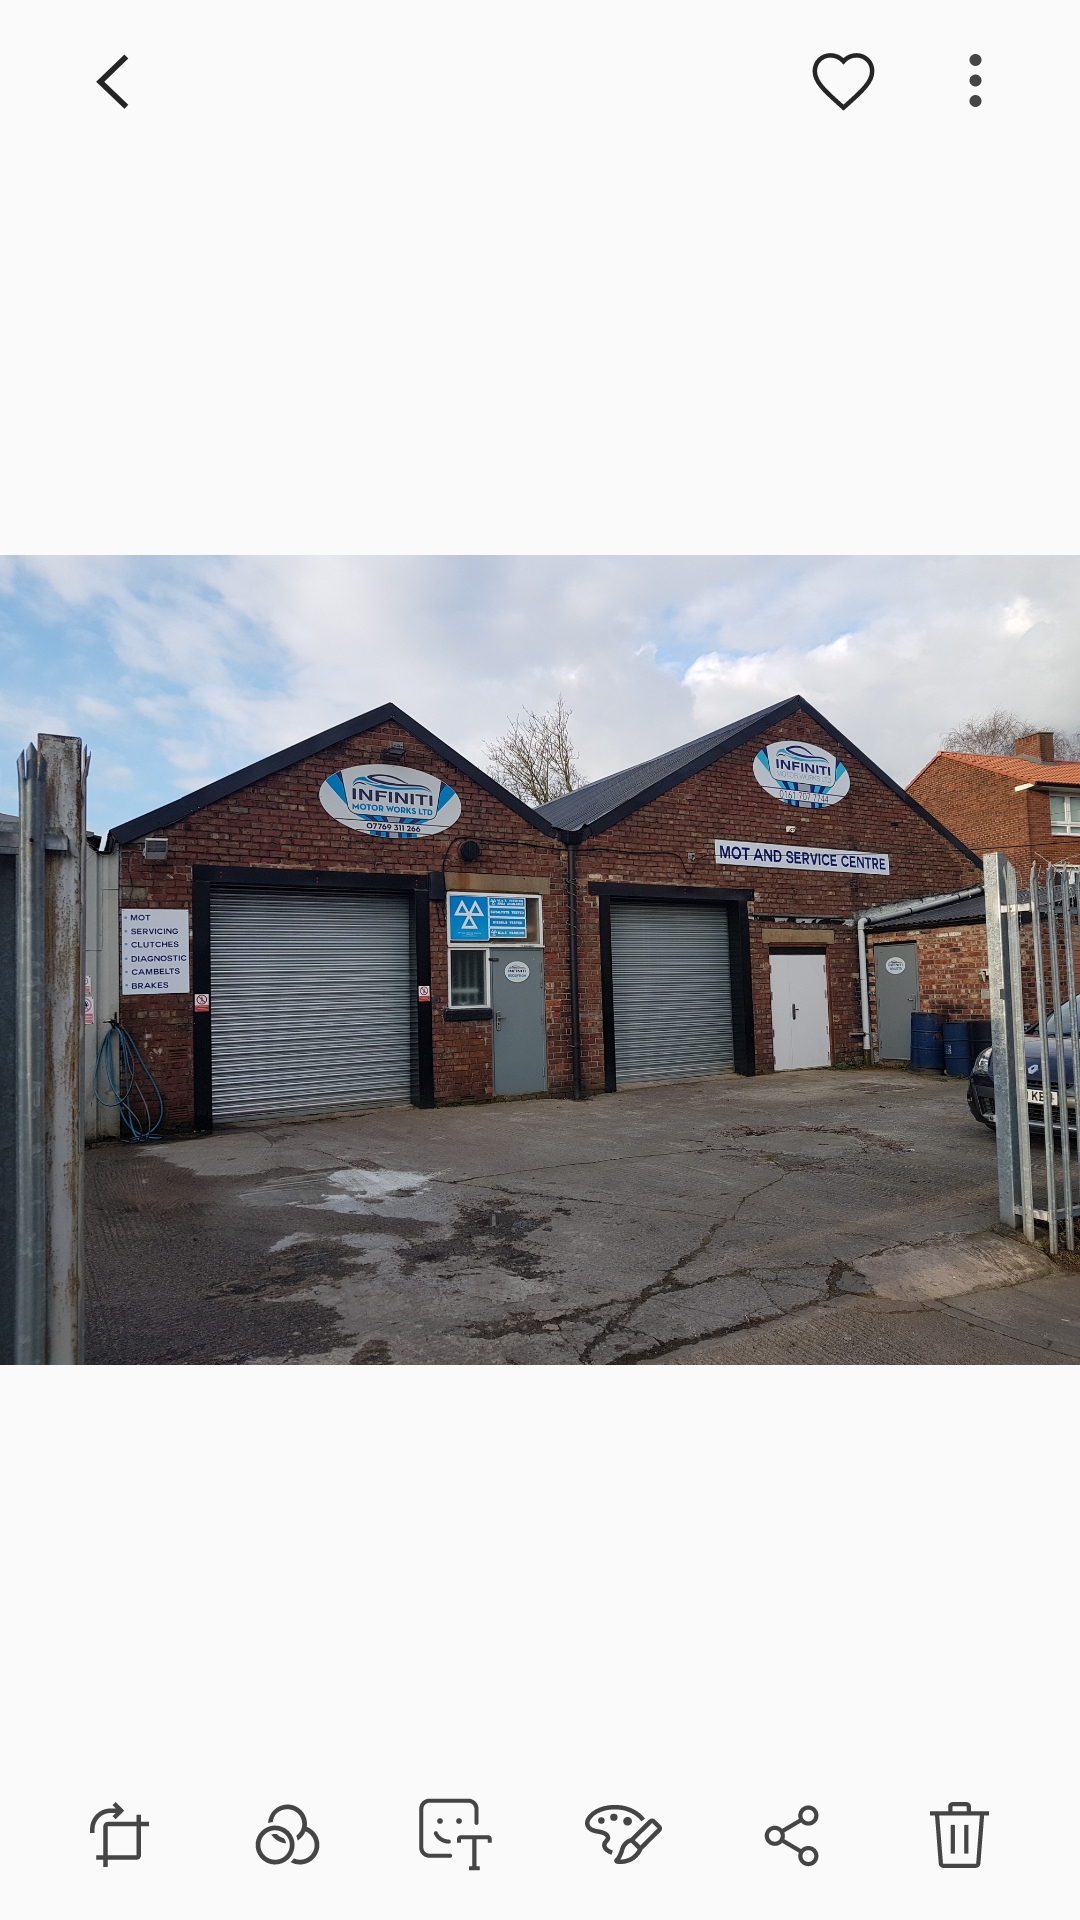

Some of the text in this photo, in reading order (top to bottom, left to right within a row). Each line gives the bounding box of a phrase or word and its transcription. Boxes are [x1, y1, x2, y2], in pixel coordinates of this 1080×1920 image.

[776, 759, 831, 776] INFINITI
[776, 770, 798, 778] MOTOR
[800, 773, 820, 782] WORKS
[352, 788, 434, 806] INFINITI
[780, 790, 829, 803] 0161 707 7744
[352, 803, 384, 812] MOTOR
[386, 806, 416, 815] WORKS
[719, 845, 886, 870] MOT AND SERVICE CENTRE
